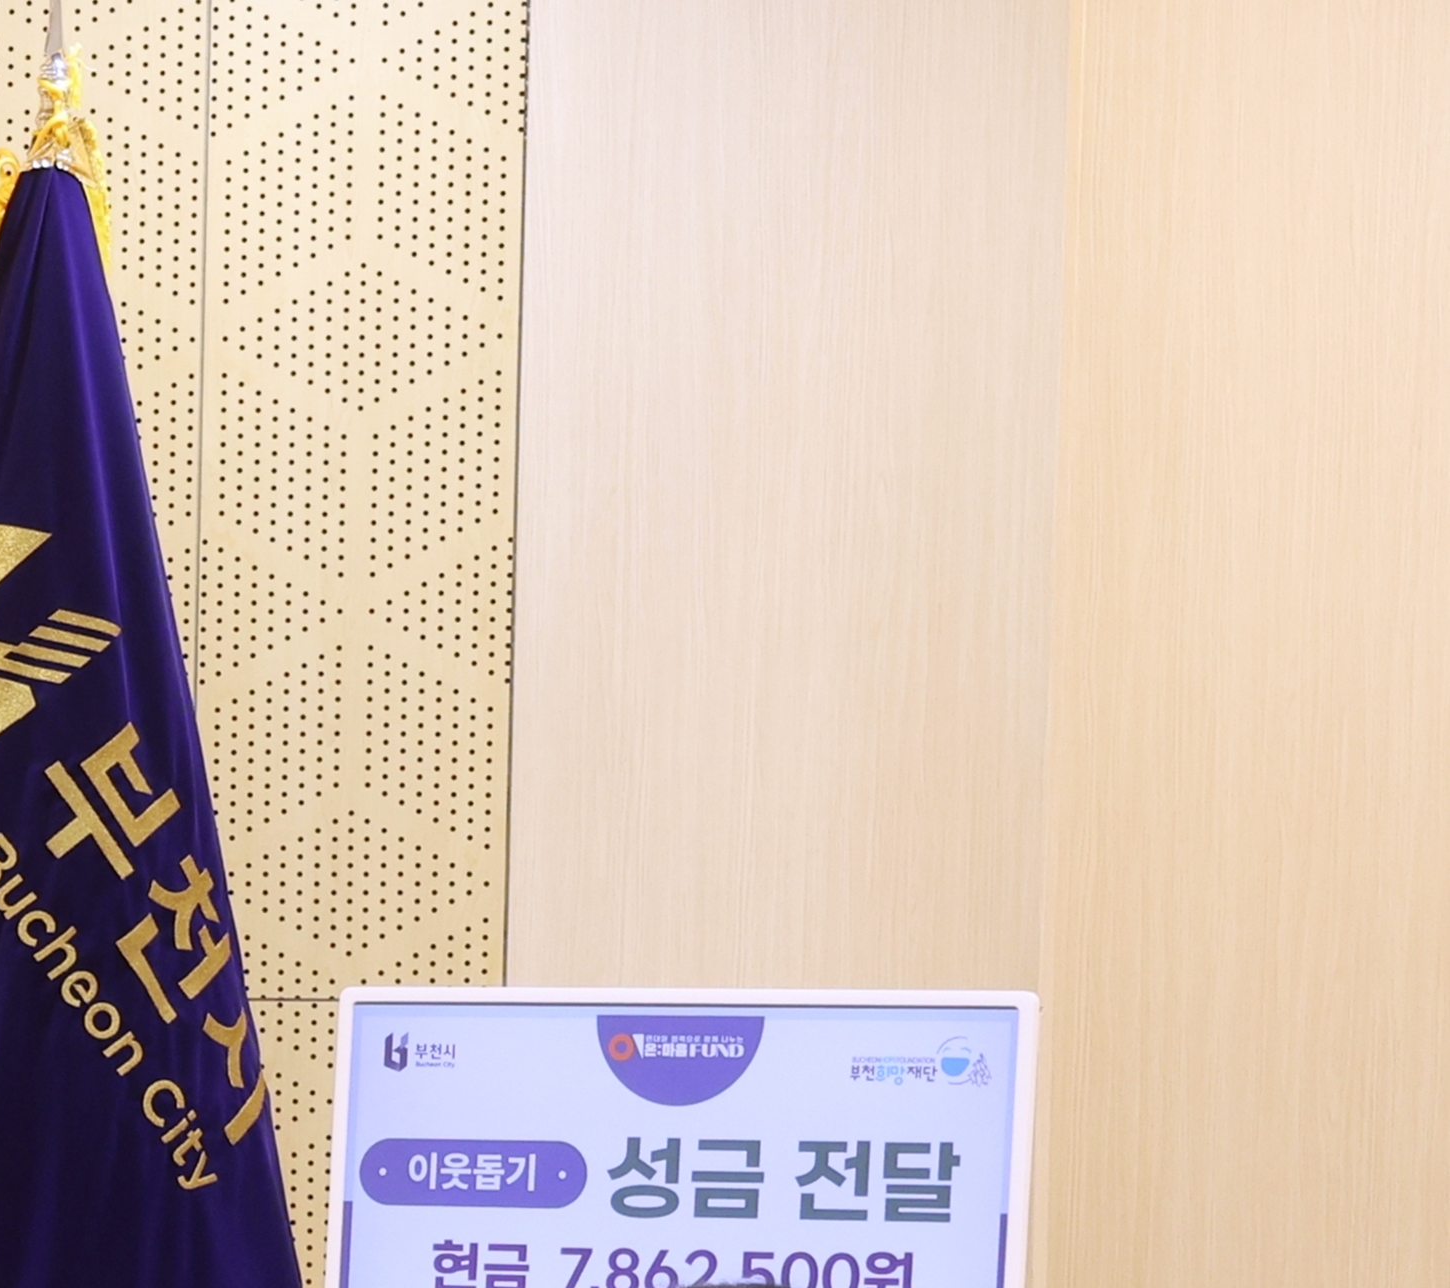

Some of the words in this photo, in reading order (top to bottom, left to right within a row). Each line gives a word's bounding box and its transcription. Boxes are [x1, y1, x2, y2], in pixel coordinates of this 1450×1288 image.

[415, 1043, 456, 1060] 부천시
[850, 1065, 938, 1086] 부천희망재단
[141, 1079, 218, 1190] City
[407, 1151, 537, 1193] 이웃돕기
[608, 1137, 765, 1220] 성금
[795, 1140, 961, 1223] 전달
